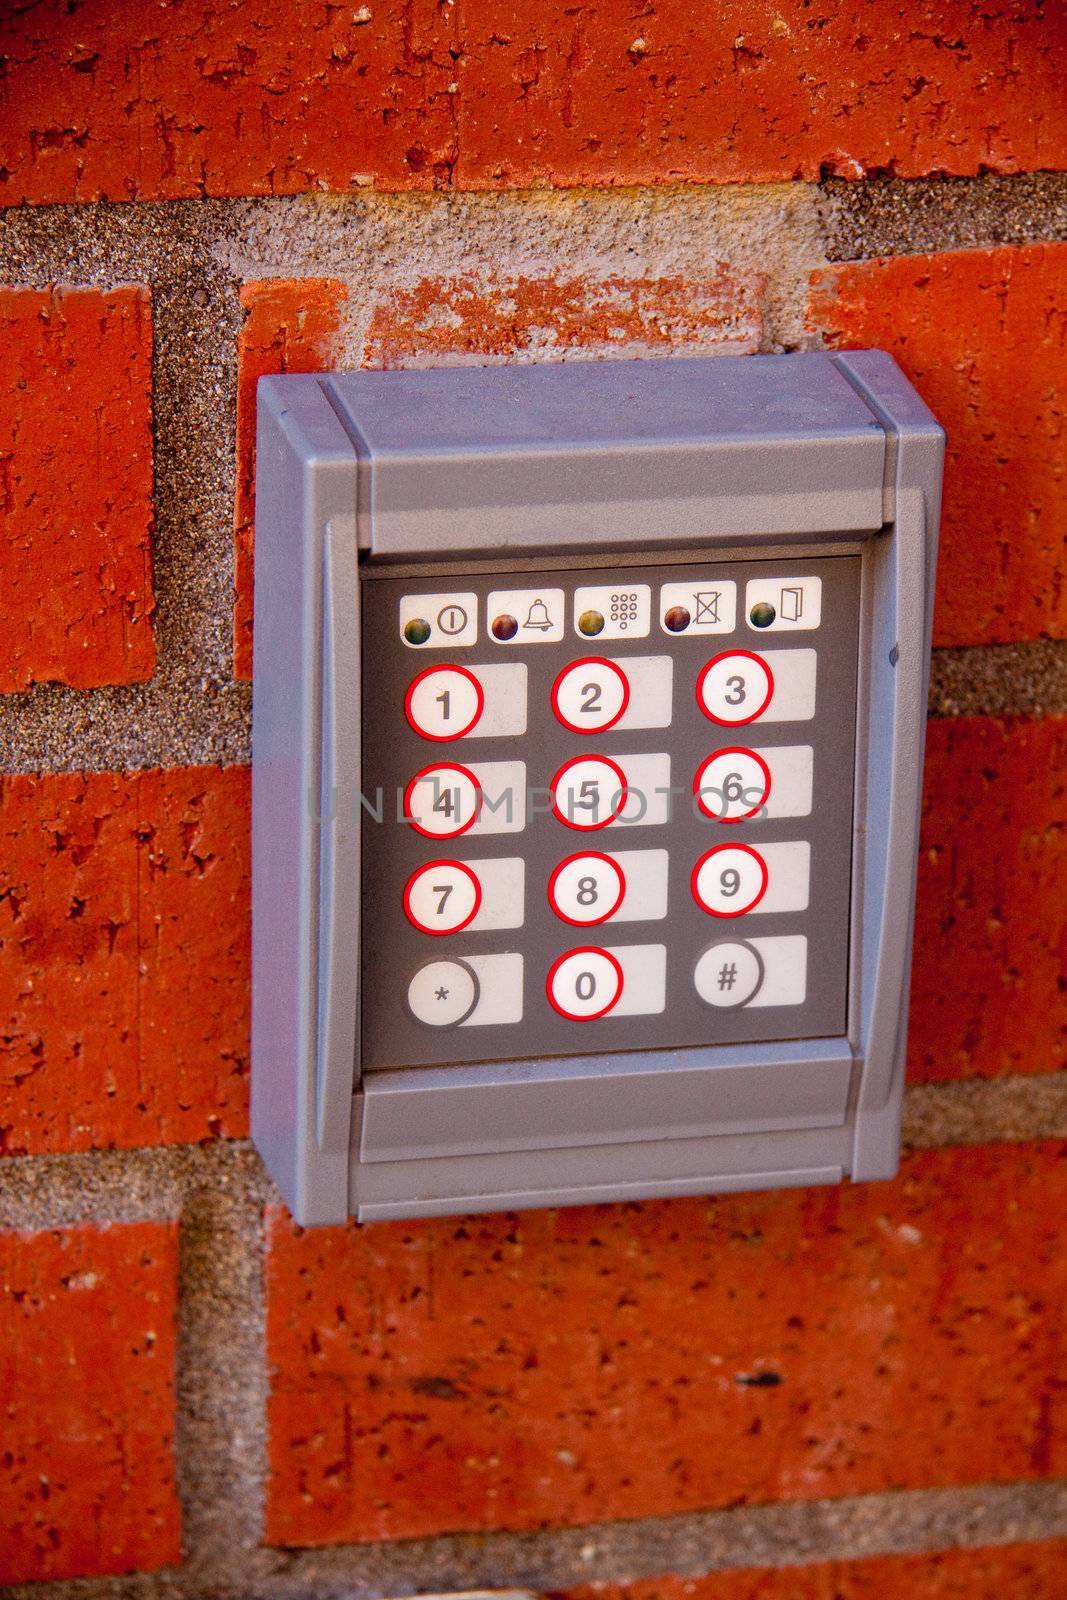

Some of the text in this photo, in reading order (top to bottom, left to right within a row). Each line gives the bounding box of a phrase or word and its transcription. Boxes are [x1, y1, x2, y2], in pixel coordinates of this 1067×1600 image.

[436, 690, 450, 720] 1
[580, 683, 602, 713] 2
[724, 675, 746, 706] 3
[577, 780, 600, 810] 5
[722, 772, 744, 802] 6
[432, 788, 455, 818] 4
[576, 876, 598, 906] 8
[720, 868, 741, 897] 9
[432, 885, 453, 915] 7
[575, 972, 596, 1001] 0
[717, 963, 738, 991] #
